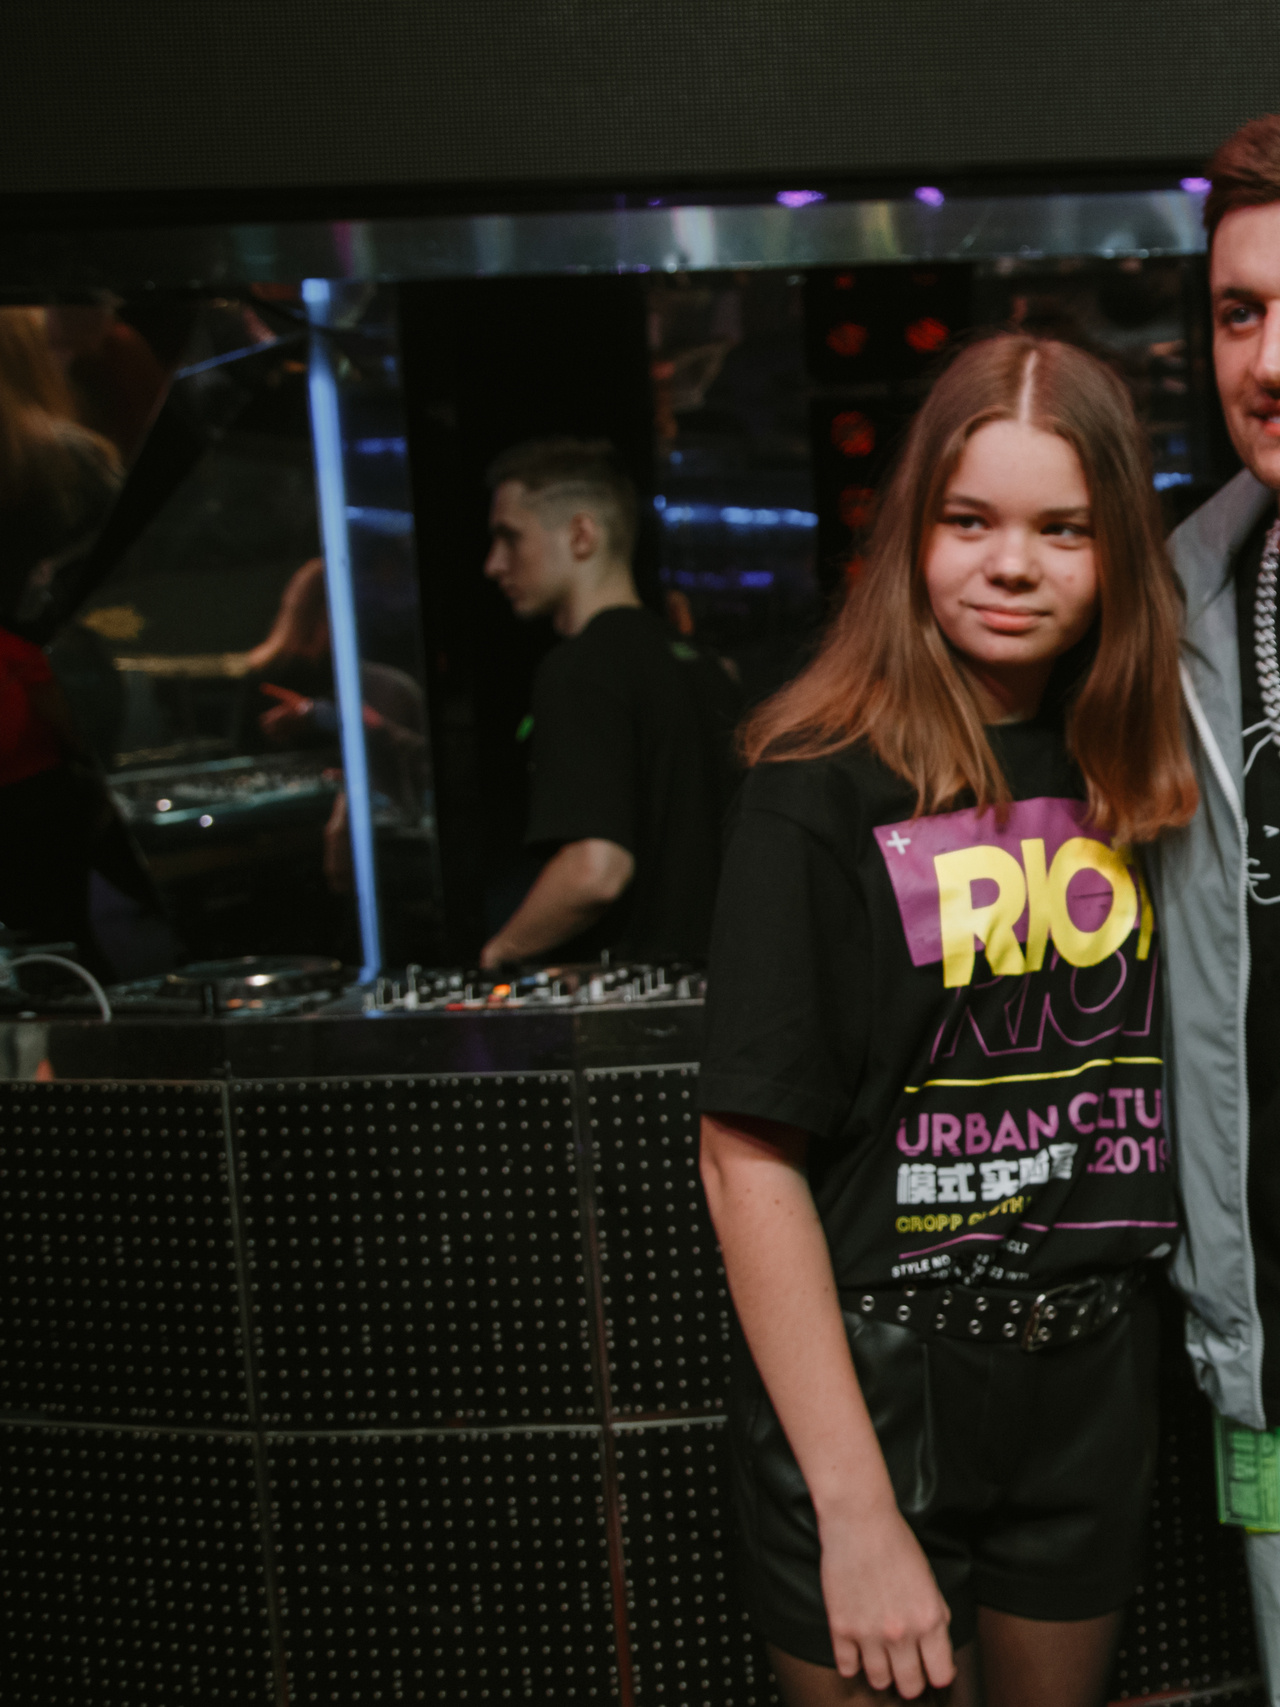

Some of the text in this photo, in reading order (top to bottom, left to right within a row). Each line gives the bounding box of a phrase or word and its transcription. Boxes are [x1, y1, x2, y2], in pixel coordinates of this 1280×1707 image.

[896, 1105, 1059, 1157] URBAN
[895, 1213, 963, 1234] CROPP
[891, 1258, 931, 1279] STYLE
